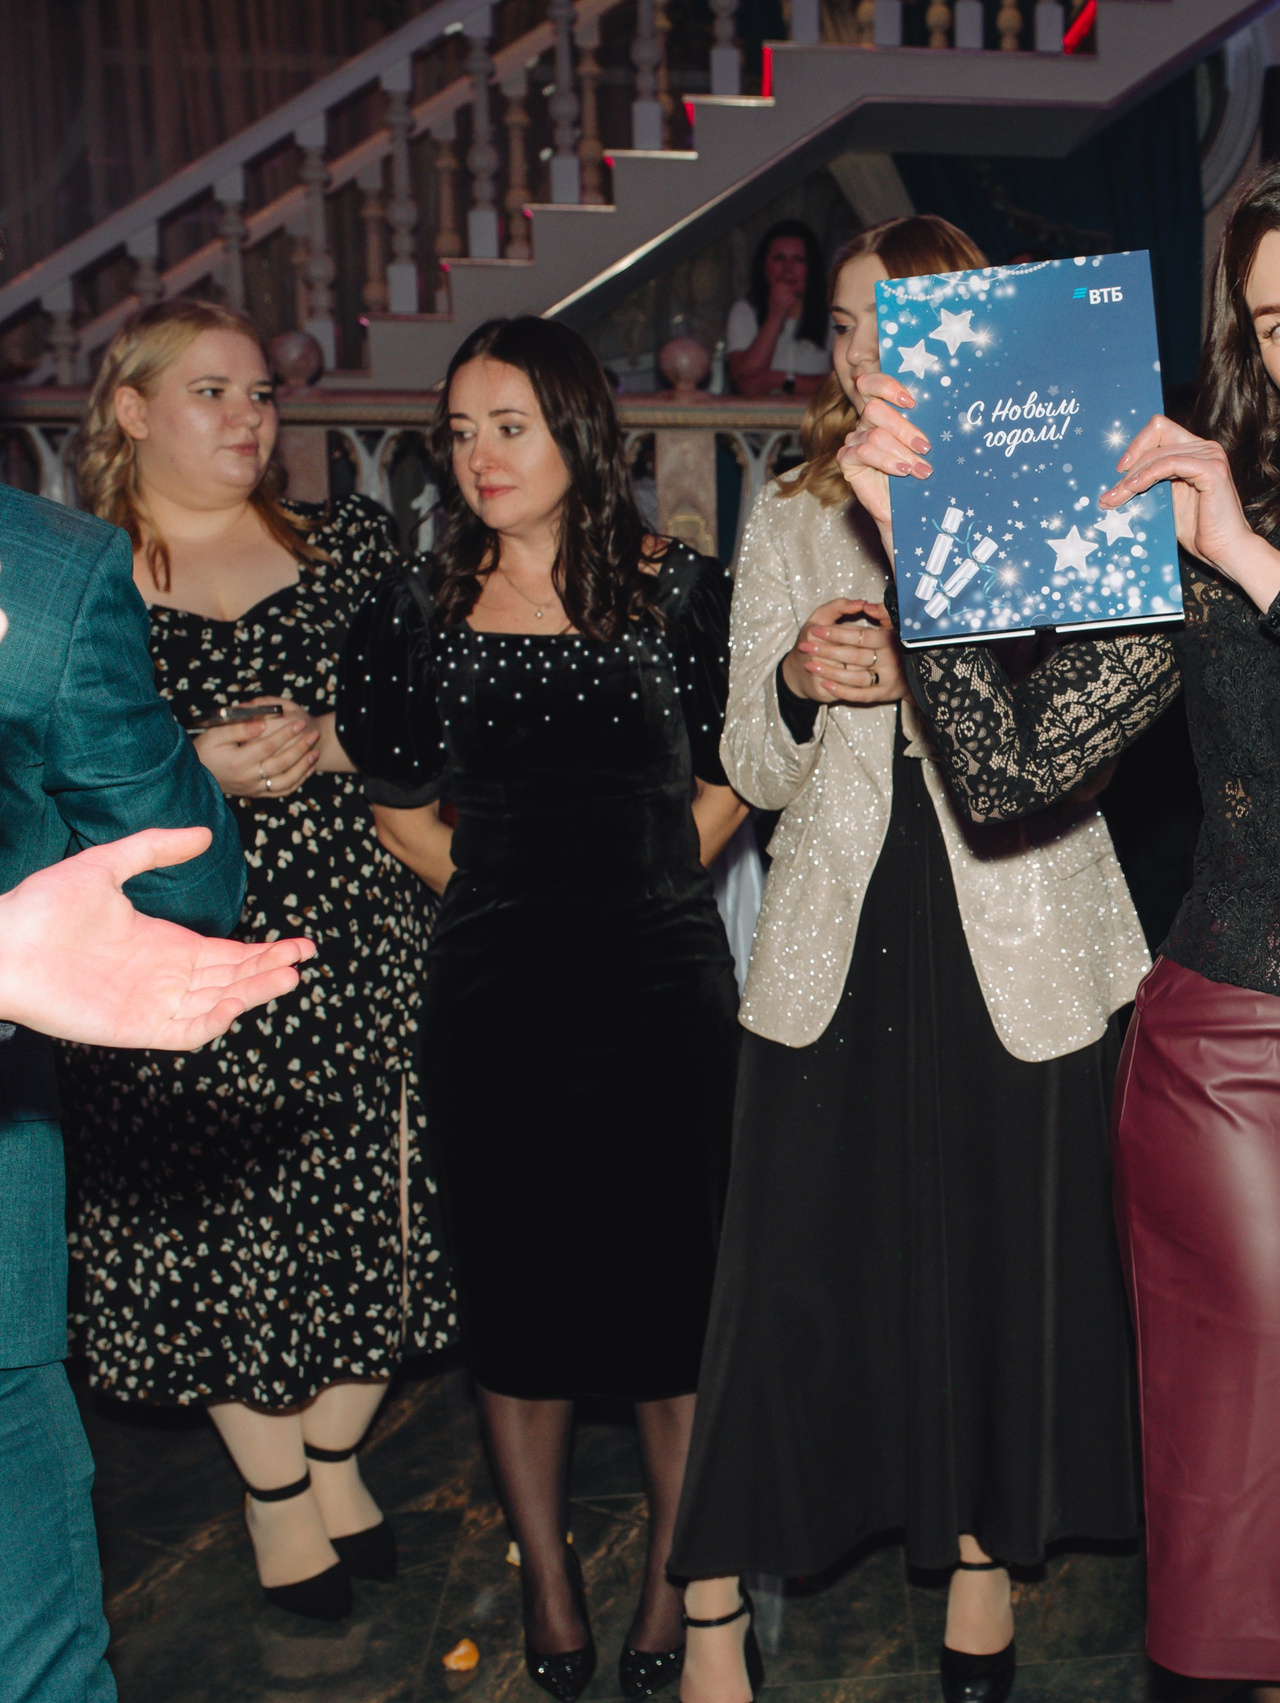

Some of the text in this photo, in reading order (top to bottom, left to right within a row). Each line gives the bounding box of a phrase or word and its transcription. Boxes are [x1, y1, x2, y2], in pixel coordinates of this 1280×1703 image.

[1088, 286, 1124, 305] ВТБ
[966, 390, 1080, 425] С Новым
[983, 415, 1072, 458] годом!
